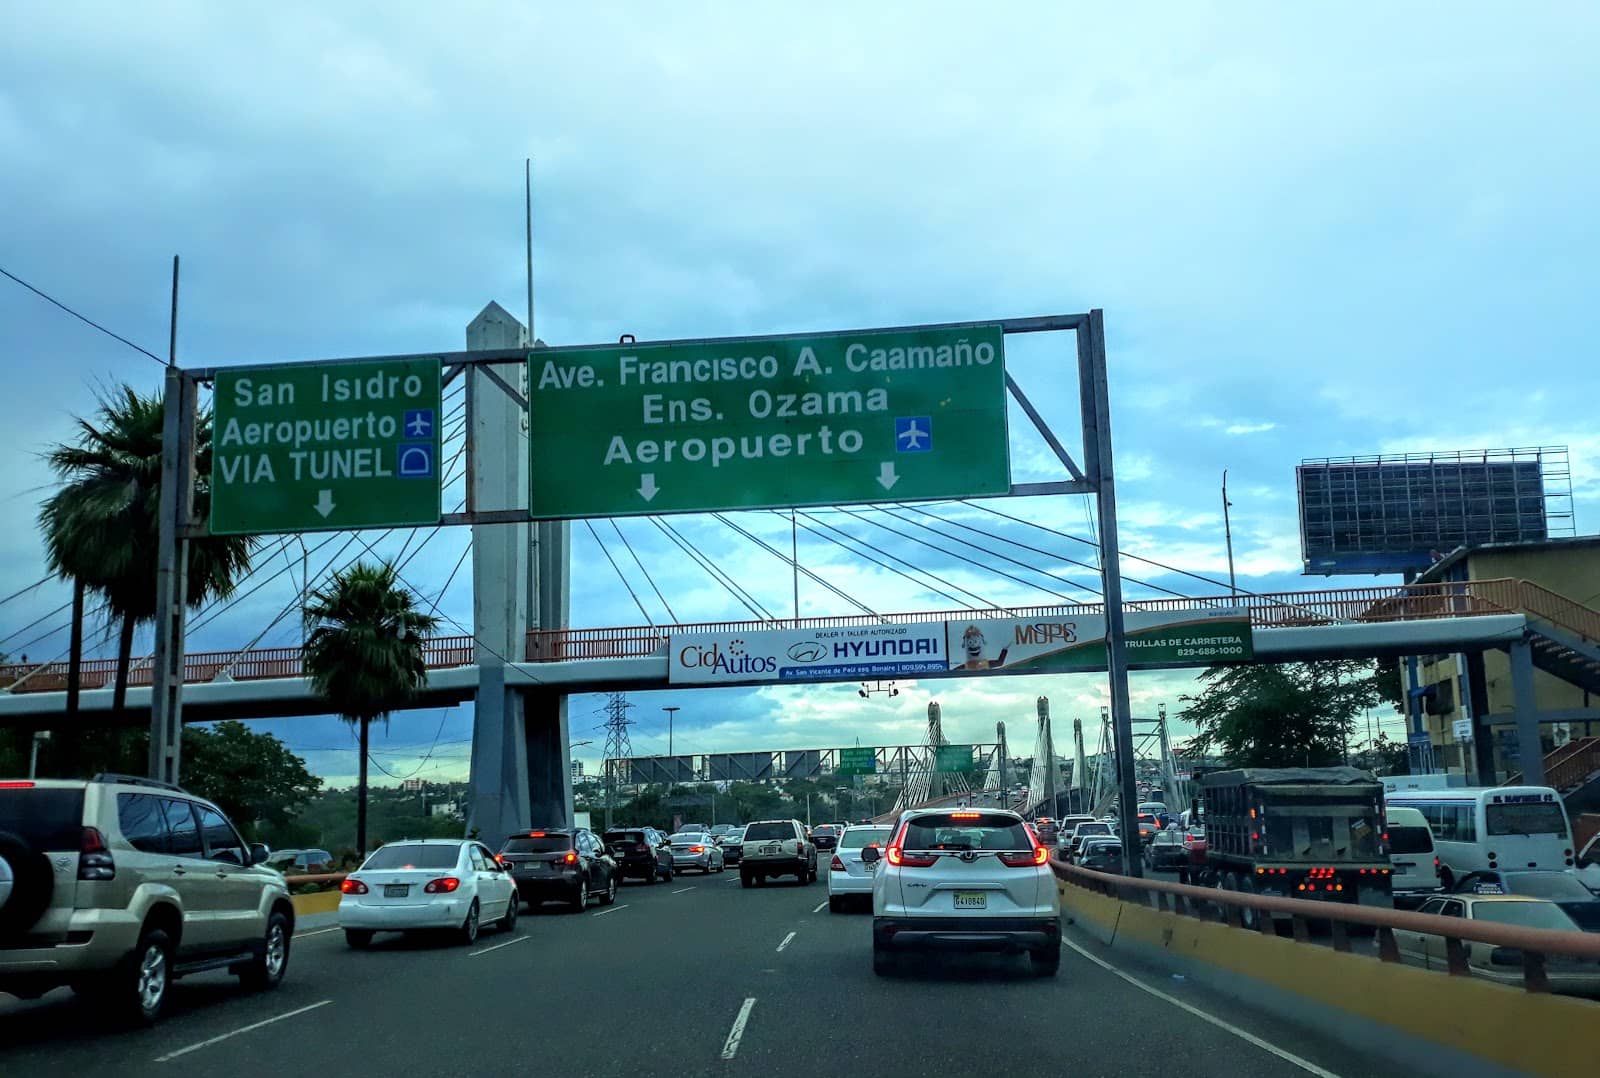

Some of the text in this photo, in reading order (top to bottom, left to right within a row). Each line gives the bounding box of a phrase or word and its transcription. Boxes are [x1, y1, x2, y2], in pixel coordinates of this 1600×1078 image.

[538, 338, 995, 389] Ave. Francisco A. Caamaño
[234, 370, 422, 406] San Isidro
[643, 387, 888, 424] Ens. Ozama
[221, 411, 396, 448] Aeropuerto
[603, 425, 863, 468] Aeropuerto
[219, 448, 392, 484] VIA TUNEL
[815, 631, 839, 639] DEALER
[847, 629, 870, 637] TALLER
[871, 627, 908, 635] AUTORIZADO
[833, 638, 938, 658] HYUNDAI
[1124, 636, 1242, 648] TRULLAS DE CARRETERA
